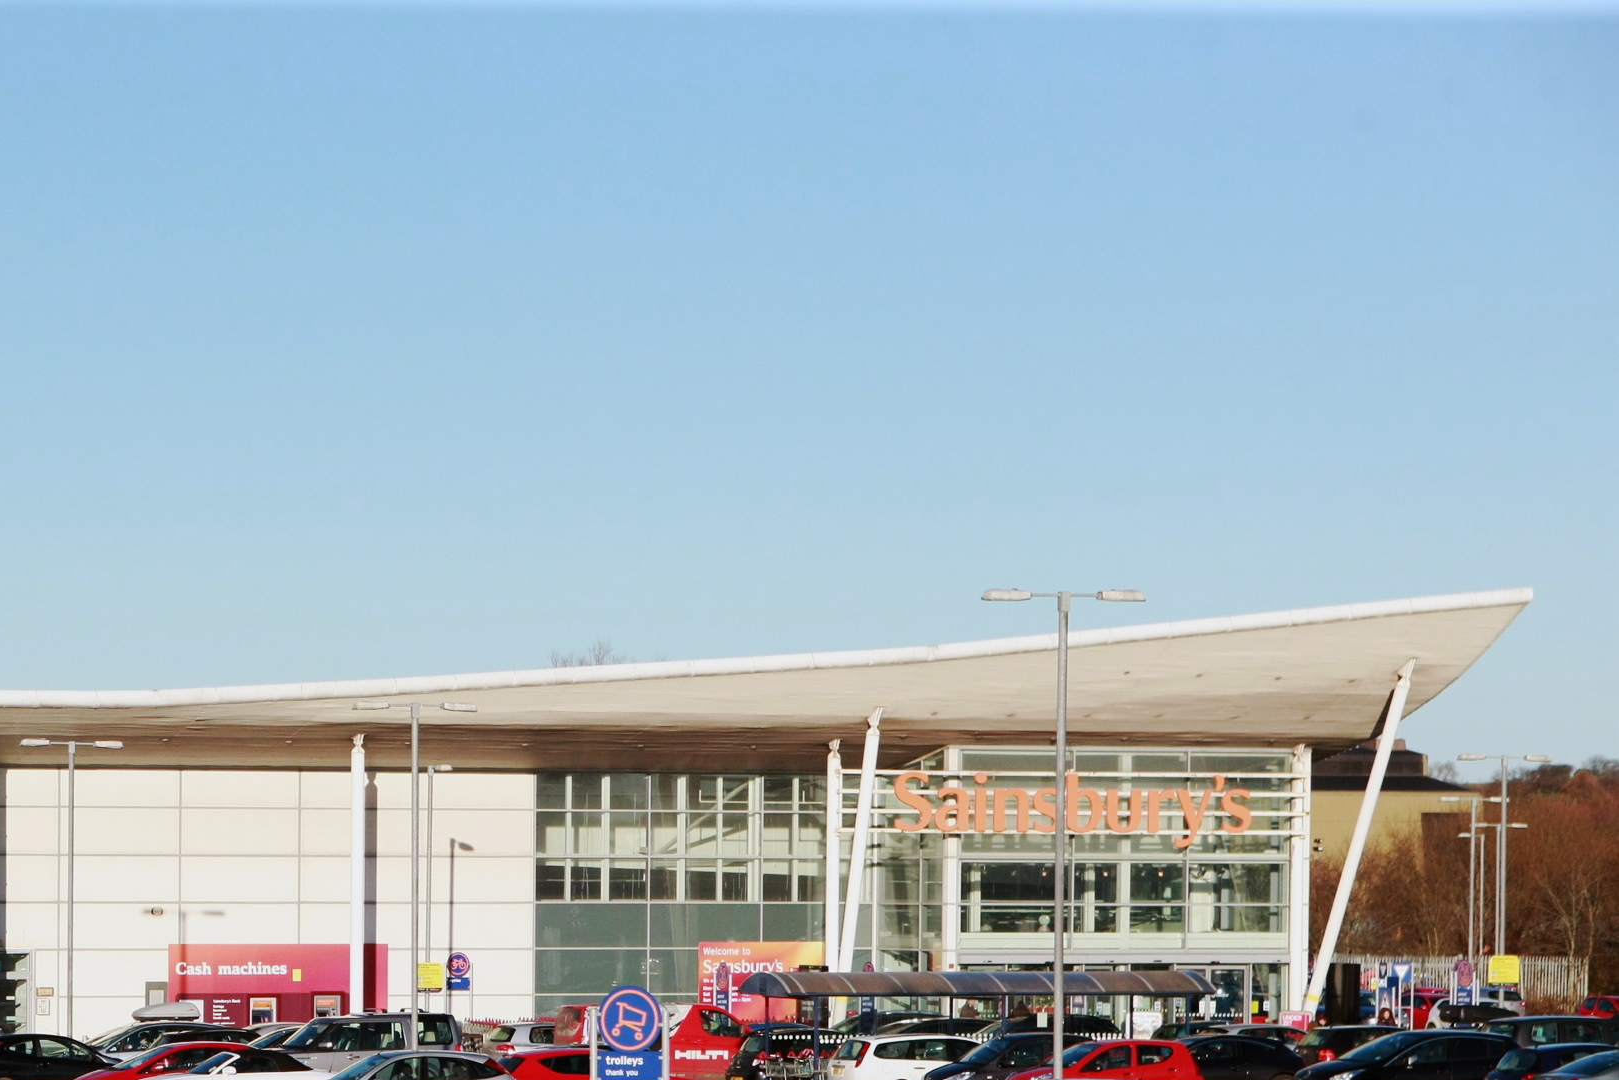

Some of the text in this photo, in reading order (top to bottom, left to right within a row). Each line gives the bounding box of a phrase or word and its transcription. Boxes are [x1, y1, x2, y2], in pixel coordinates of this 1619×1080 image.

[893, 772, 1252, 849] Sainsbury's
[703, 947, 751, 956] Welcome to
[175, 961, 287, 975] Cash machines
[674, 1050, 729, 1060] HILTI
[605, 1055, 644, 1067] trolleys
[605, 1068, 638, 1077] thank you
